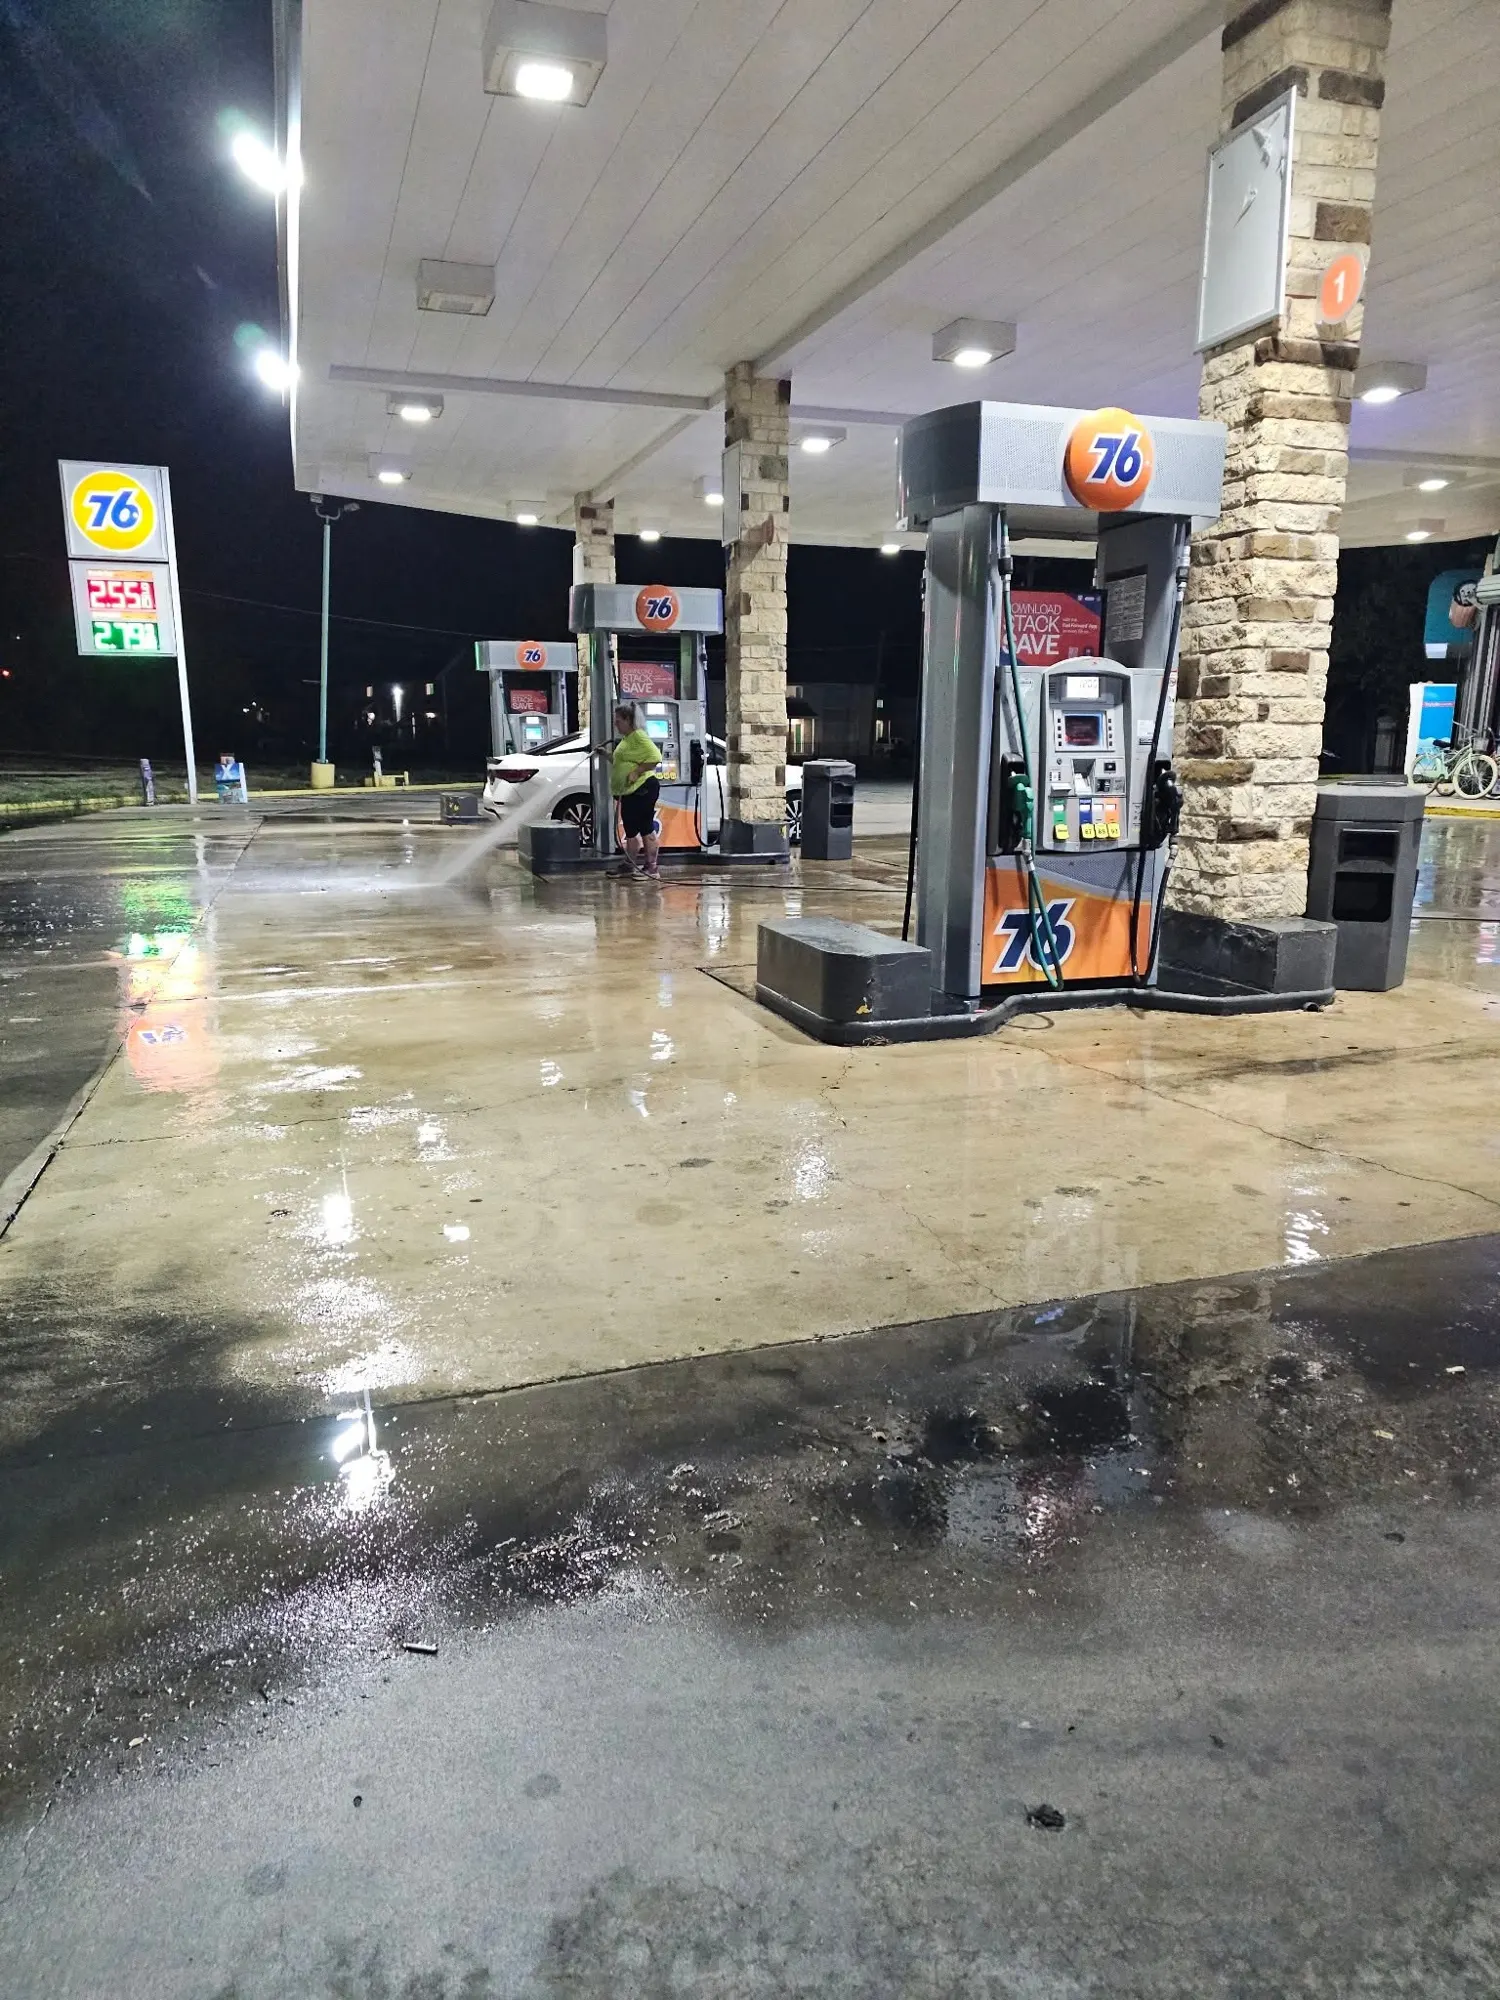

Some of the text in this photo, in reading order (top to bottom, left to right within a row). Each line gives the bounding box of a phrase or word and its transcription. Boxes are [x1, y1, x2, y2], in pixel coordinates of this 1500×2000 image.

[1332, 269, 1346, 304] 1
[1085, 428, 1144, 487] 76
[83, 488, 142, 532] 76
[645, 596, 673, 620] 76
[1007, 603, 1062, 615] OWNLOAD
[523, 648, 542, 664] 76
[622, 673, 653, 683] STACK
[622, 682, 653, 693] SAVE
[992, 898, 1077, 973] 76
